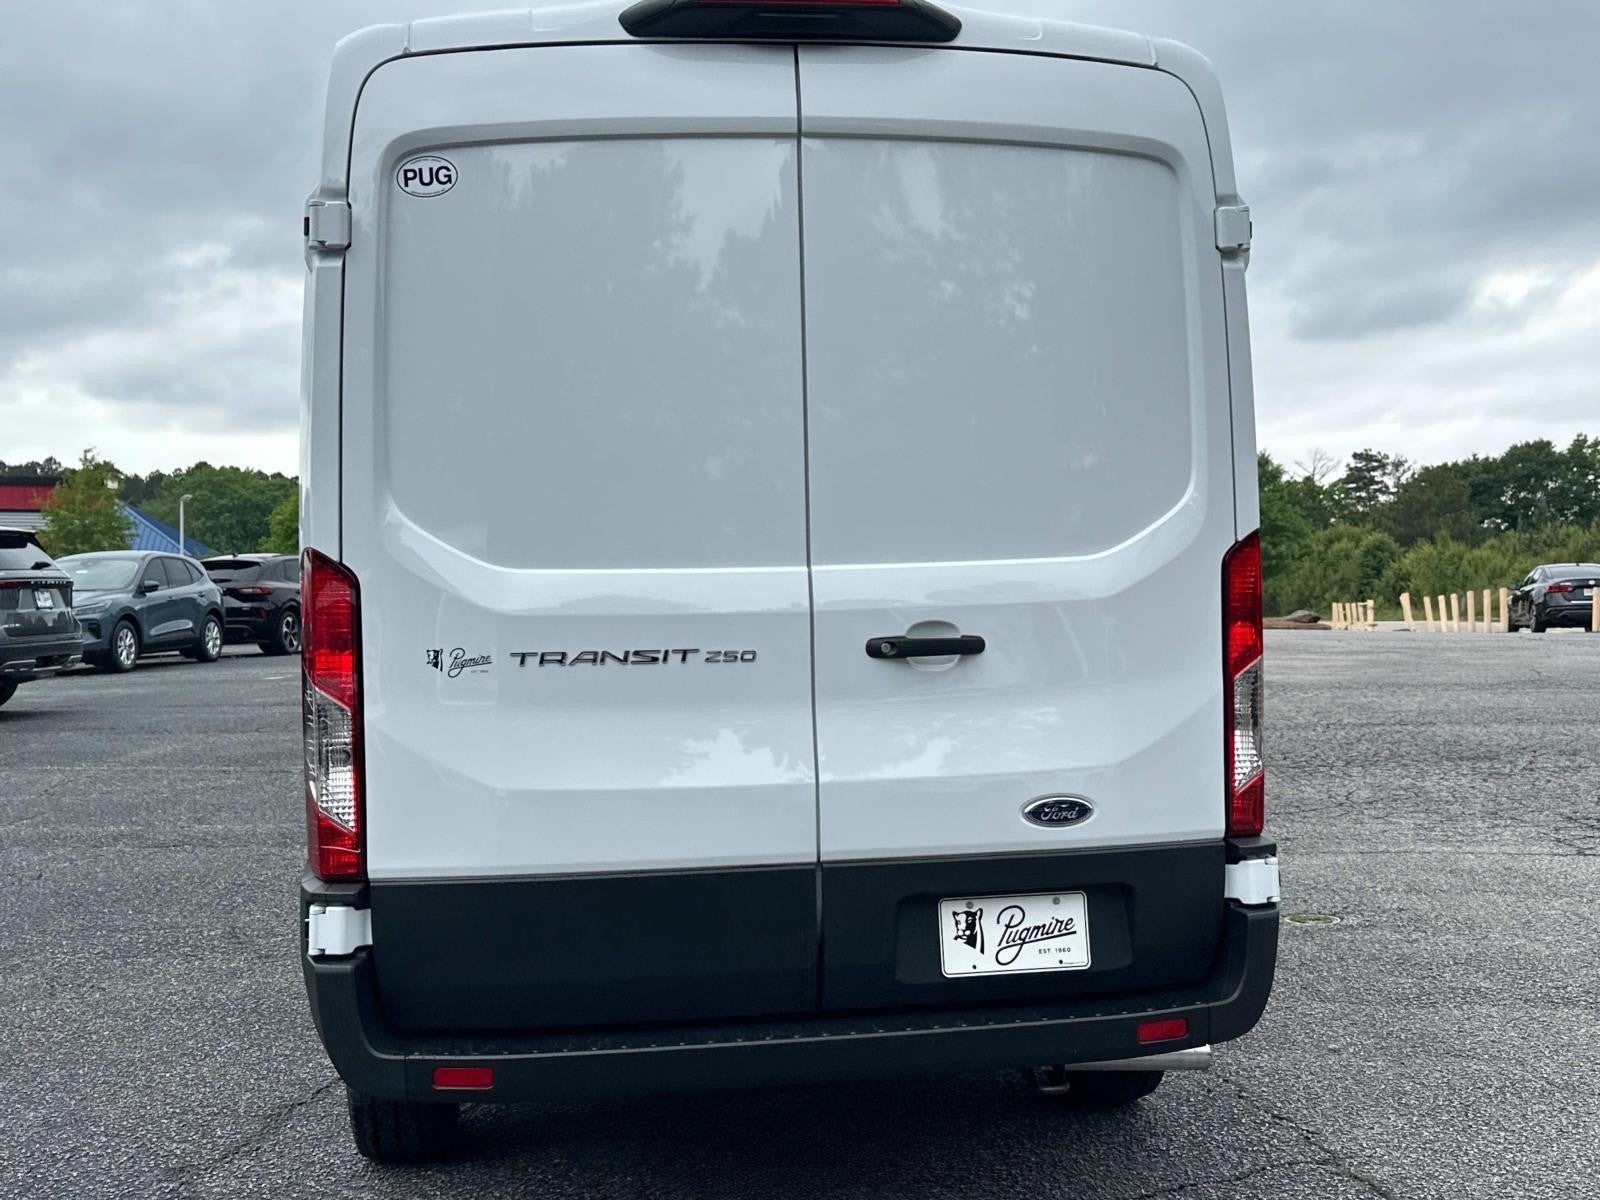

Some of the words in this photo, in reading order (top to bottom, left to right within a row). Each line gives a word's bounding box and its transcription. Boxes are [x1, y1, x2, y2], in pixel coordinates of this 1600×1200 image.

[403, 165, 453, 188] PUG
[447, 647, 493, 678] Pugmire
[510, 648, 700, 667] TRANSIT
[704, 650, 757, 663] 250
[1040, 800, 1080, 820] Ford
[995, 904, 1077, 966] Pugmire
